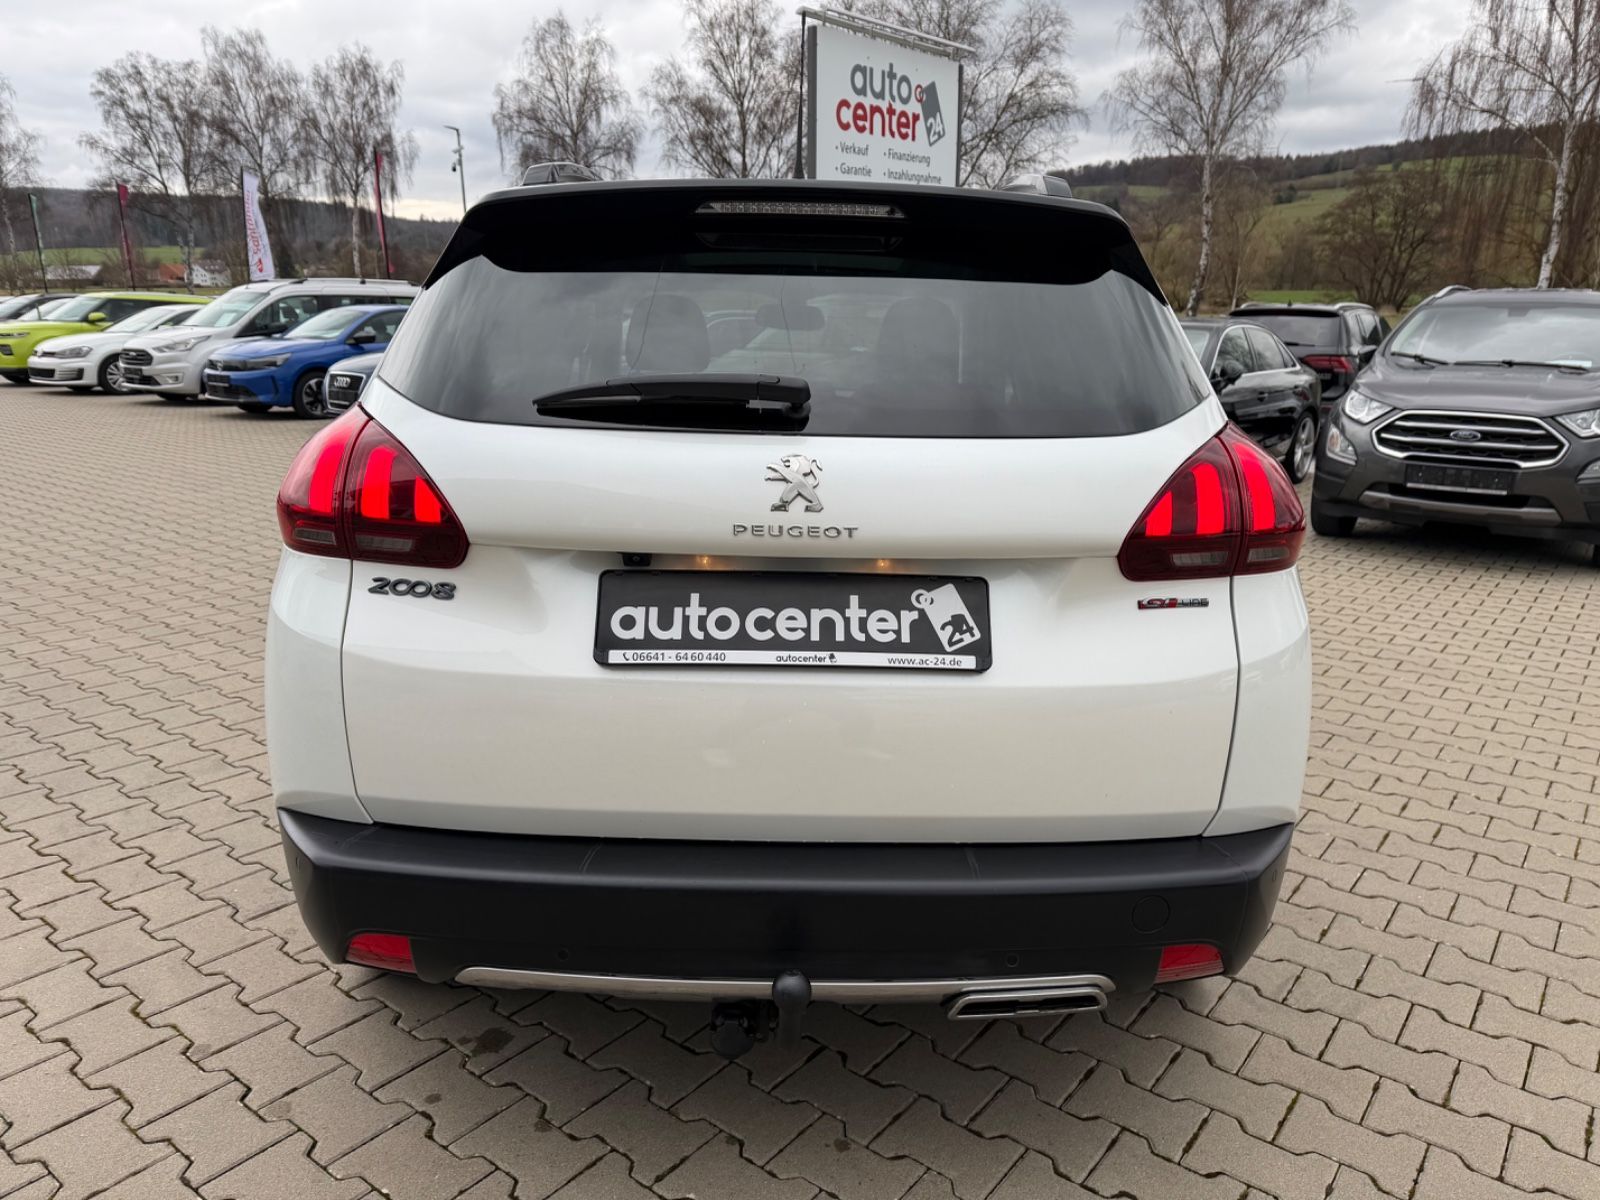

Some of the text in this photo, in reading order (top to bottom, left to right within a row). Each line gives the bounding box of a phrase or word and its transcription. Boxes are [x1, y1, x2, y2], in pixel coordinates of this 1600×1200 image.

[851, 62, 912, 105] auto
[836, 98, 920, 142] center
[927, 111, 944, 143] 24
[840, 142, 869, 156] Verkauf
[888, 148, 931, 167] Finanzierung
[840, 162, 872, 177] Garantie
[887, 168, 942, 184] Inzahlungnahme
[733, 524, 859, 539] PEUGEOT
[368, 577, 457, 600] 2008
[939, 613, 975, 648] 24
[632, 652, 665, 661] 06641
[776, 653, 827, 663] autocenter
[887, 657, 962, 667] www.ac-24.de
